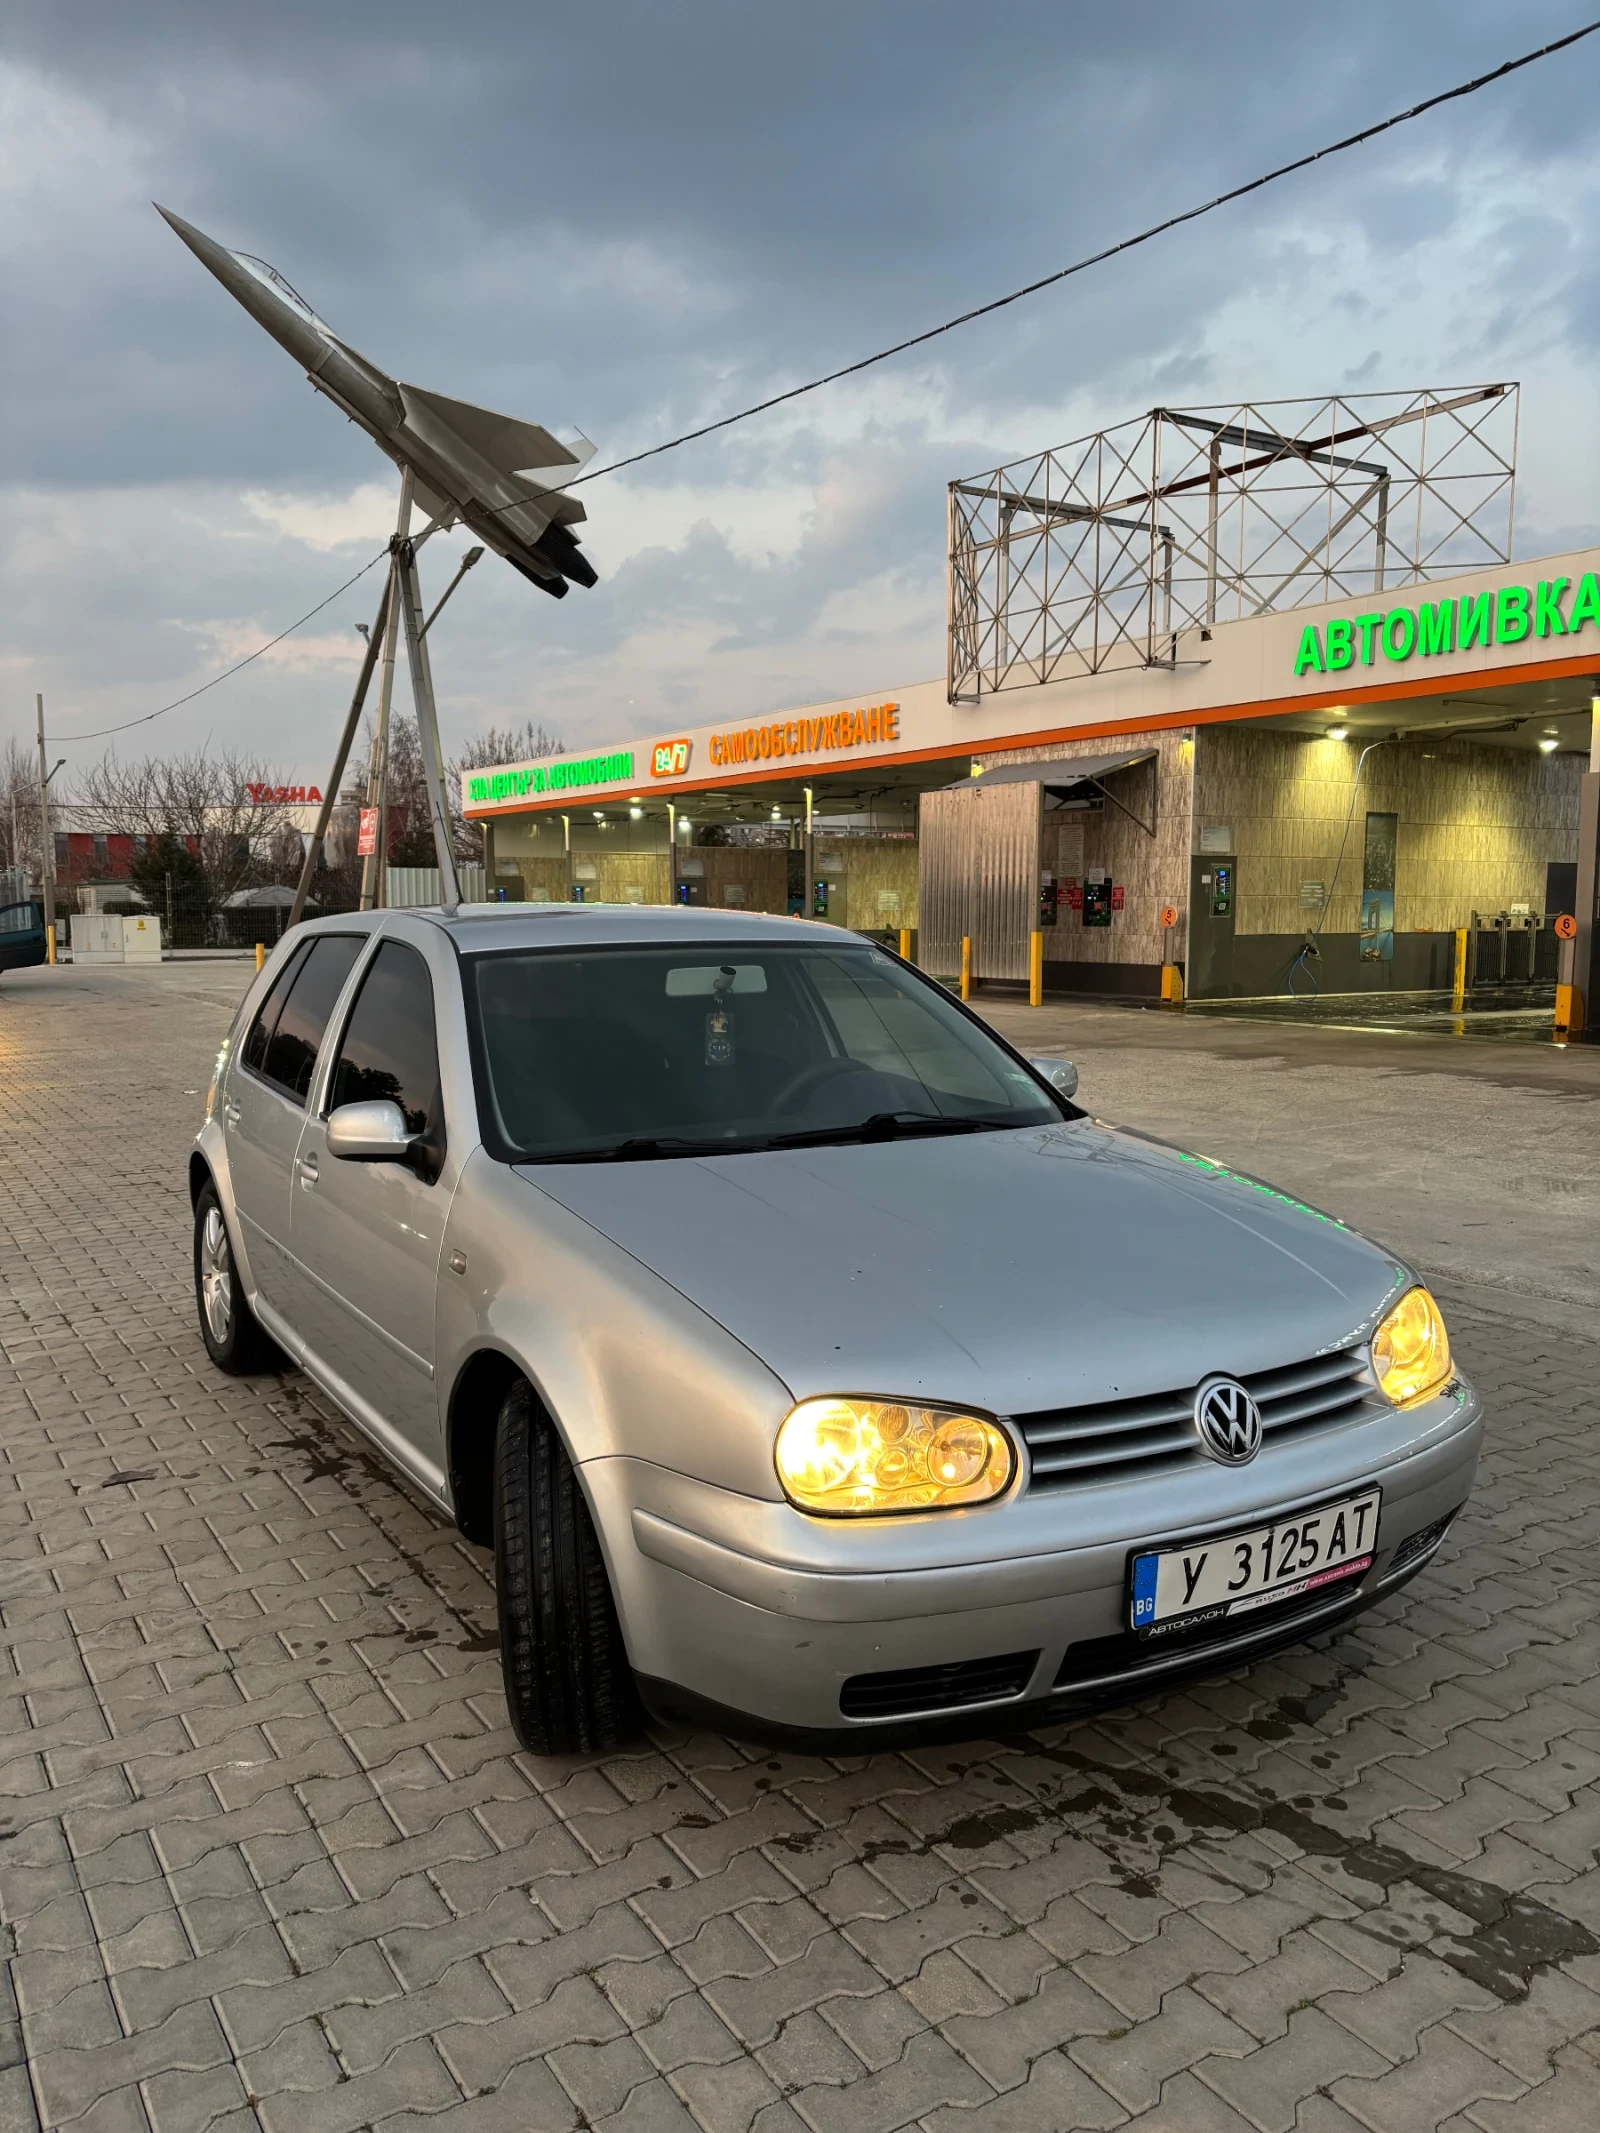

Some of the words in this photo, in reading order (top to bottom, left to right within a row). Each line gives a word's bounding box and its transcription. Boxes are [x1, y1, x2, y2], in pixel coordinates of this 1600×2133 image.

[1293, 572, 1600, 676] АВТОМИВКА
[709, 702, 899, 766] САМООБСЛУЖВАНЕ
[469, 777, 488, 801] СПА
[490, 769, 531, 802] ЦЕНТЪР
[532, 766, 547, 792] ЗА
[549, 752, 633, 790] АВТОМОБИЛИ
[655, 743, 687, 773] 24/7
[1563, 918, 1570, 929] 6
[1227, 1519, 1320, 1591] 3125
[1136, 1597, 1153, 1616] BG
[1149, 1607, 1225, 1637] АВТОСАЛОН
